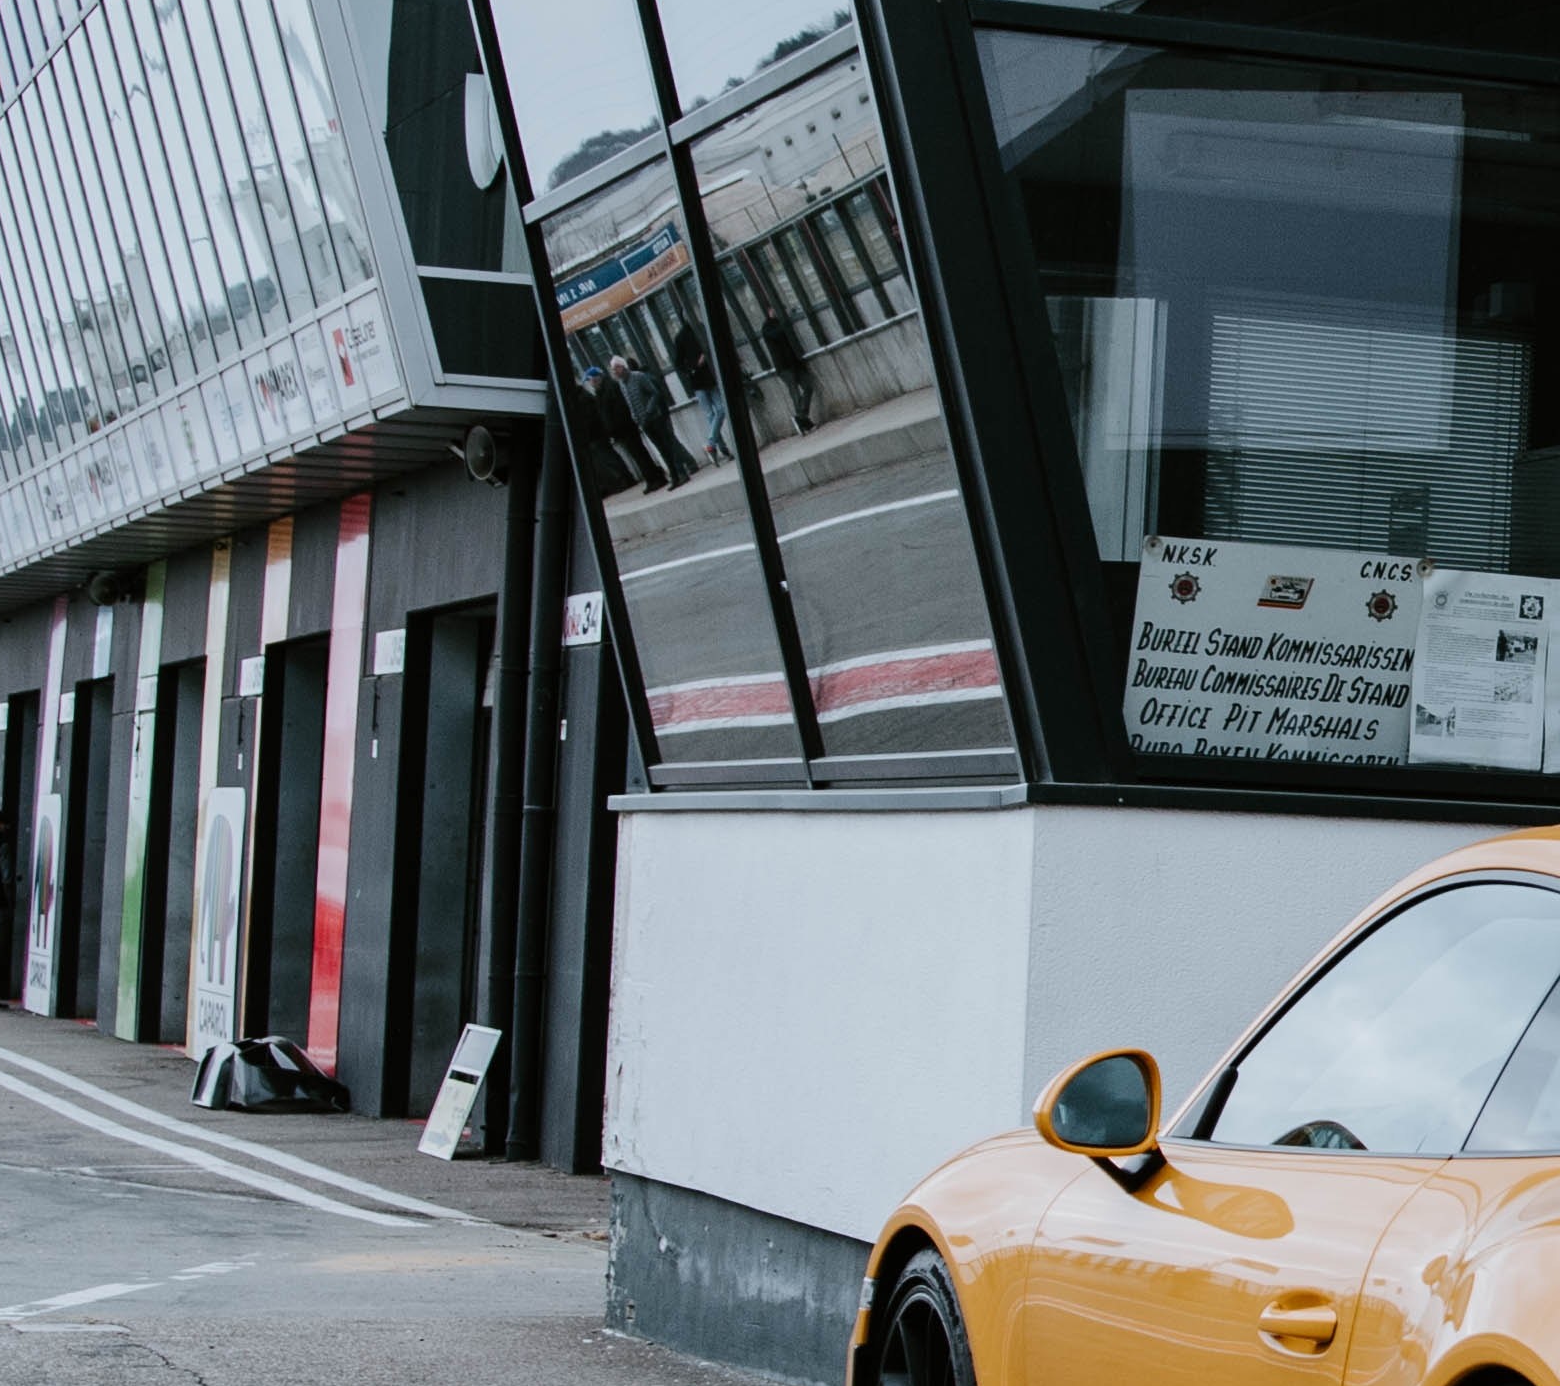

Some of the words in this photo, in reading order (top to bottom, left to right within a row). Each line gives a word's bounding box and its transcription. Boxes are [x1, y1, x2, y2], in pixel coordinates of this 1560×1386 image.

[1161, 543, 1218, 567] N.K.S.K.
[1359, 560, 1413, 583] C.N.C.S.
[1205, 627, 1263, 660] STAND
[1132, 658, 1200, 691] BUREAU
[1347, 675, 1411, 708] STAND
[1265, 707, 1380, 741] MARSHALS
